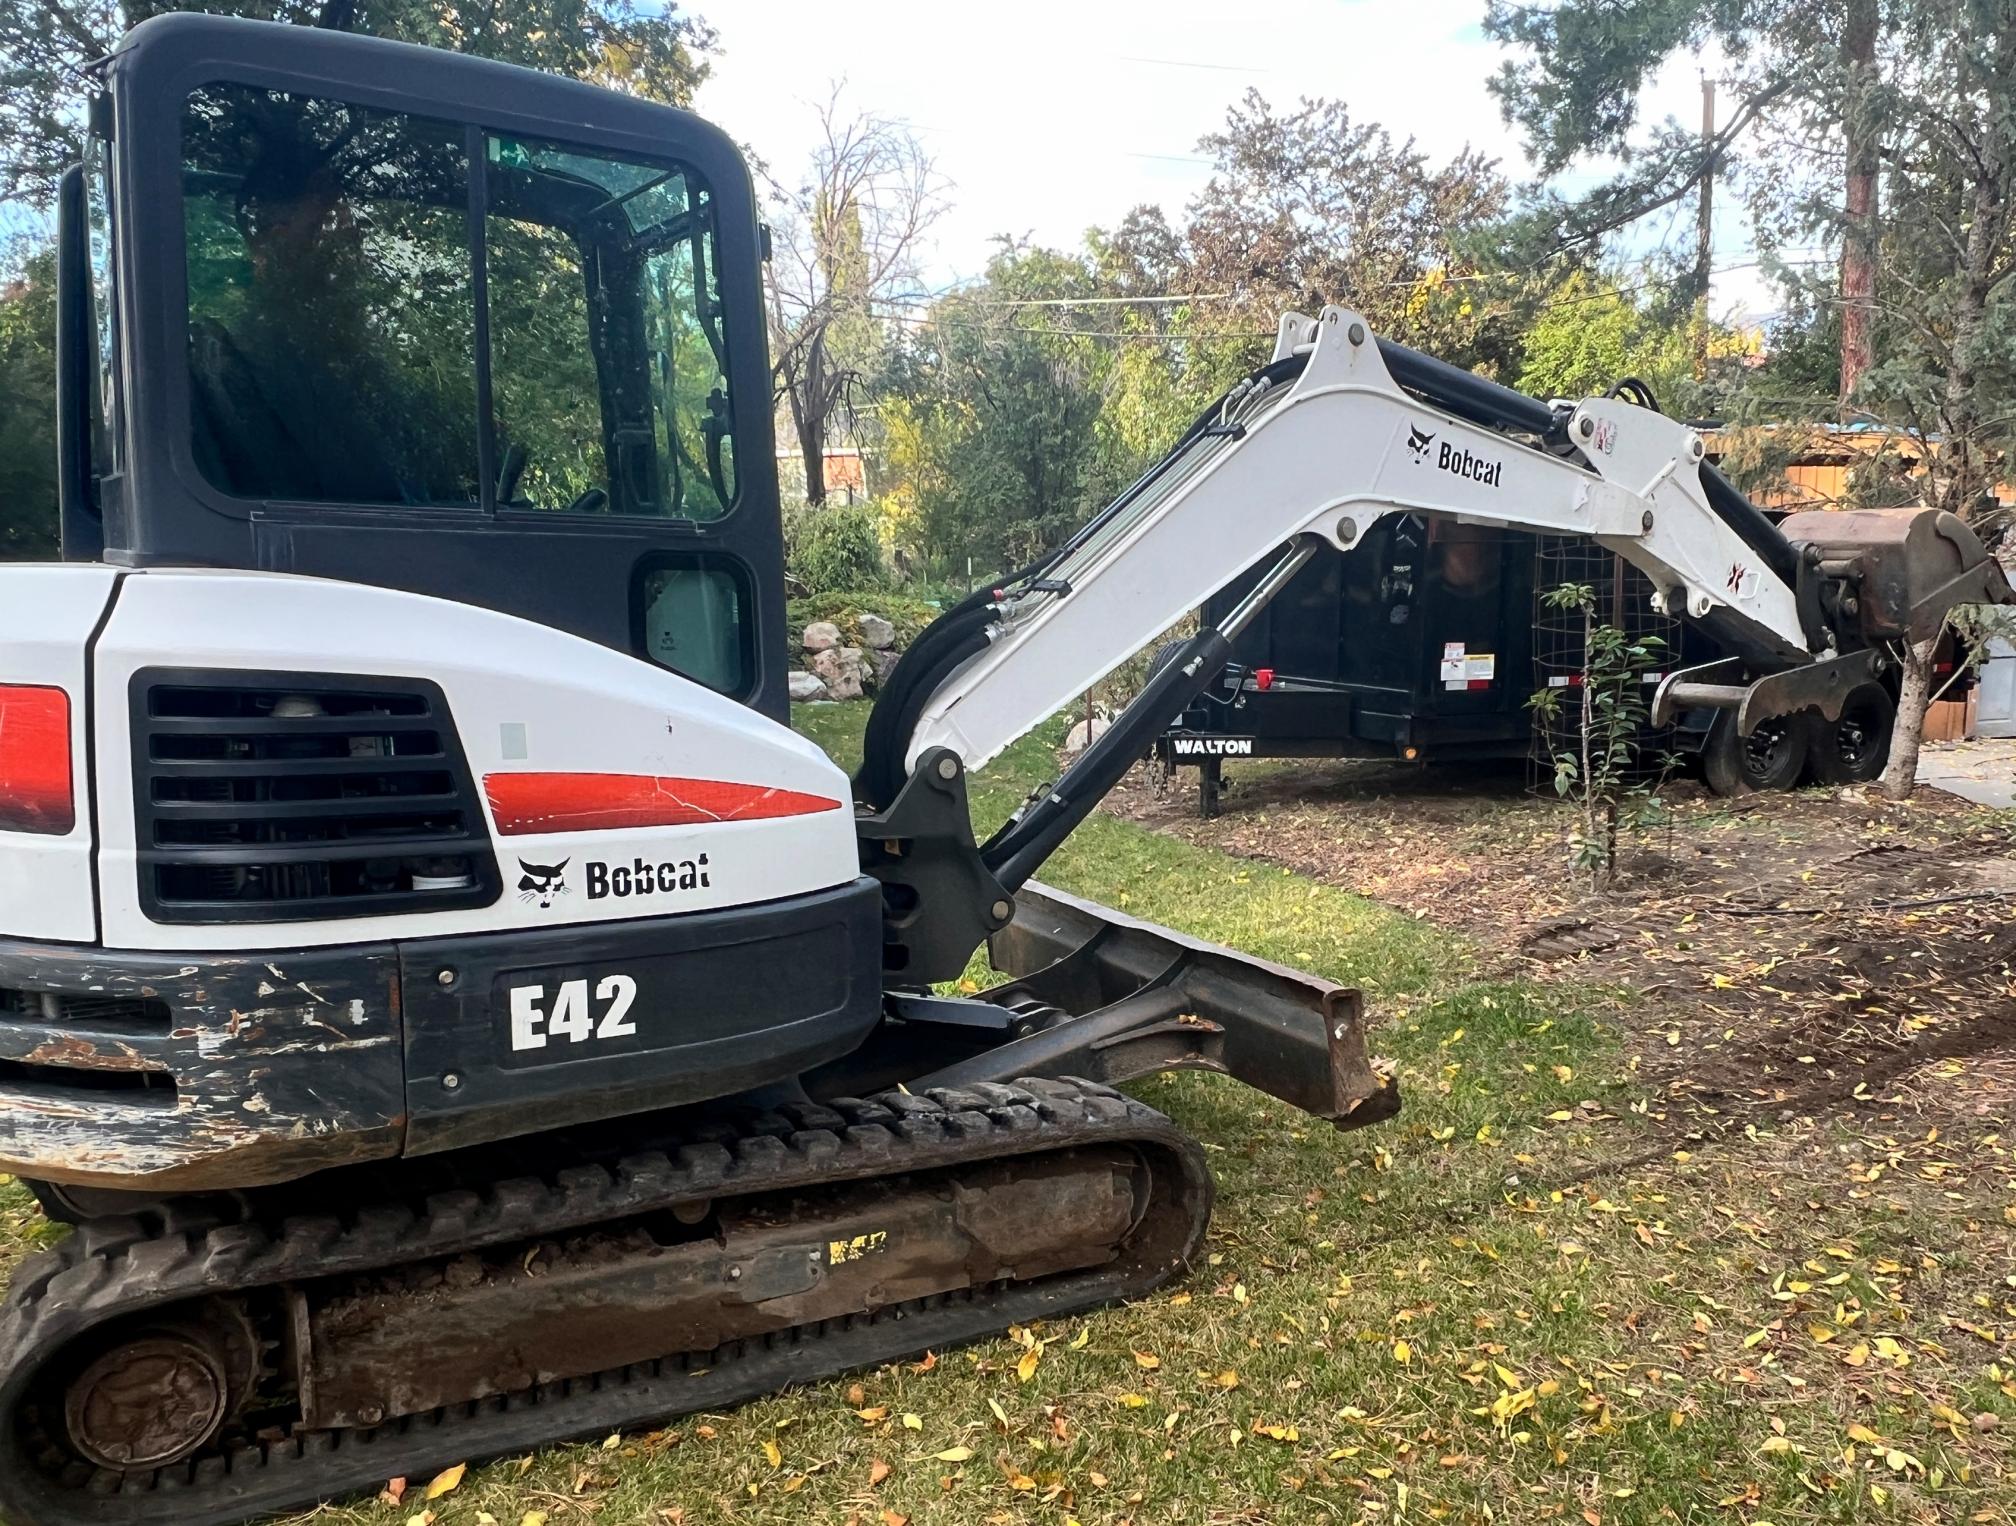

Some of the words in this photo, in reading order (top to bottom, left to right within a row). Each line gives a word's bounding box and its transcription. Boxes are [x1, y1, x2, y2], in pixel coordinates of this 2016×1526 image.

[1438, 441, 1502, 488] Bobcat
[1174, 740, 1252, 754] WALTON
[585, 853, 710, 900] Bobcat
[510, 974, 637, 1051] E42
